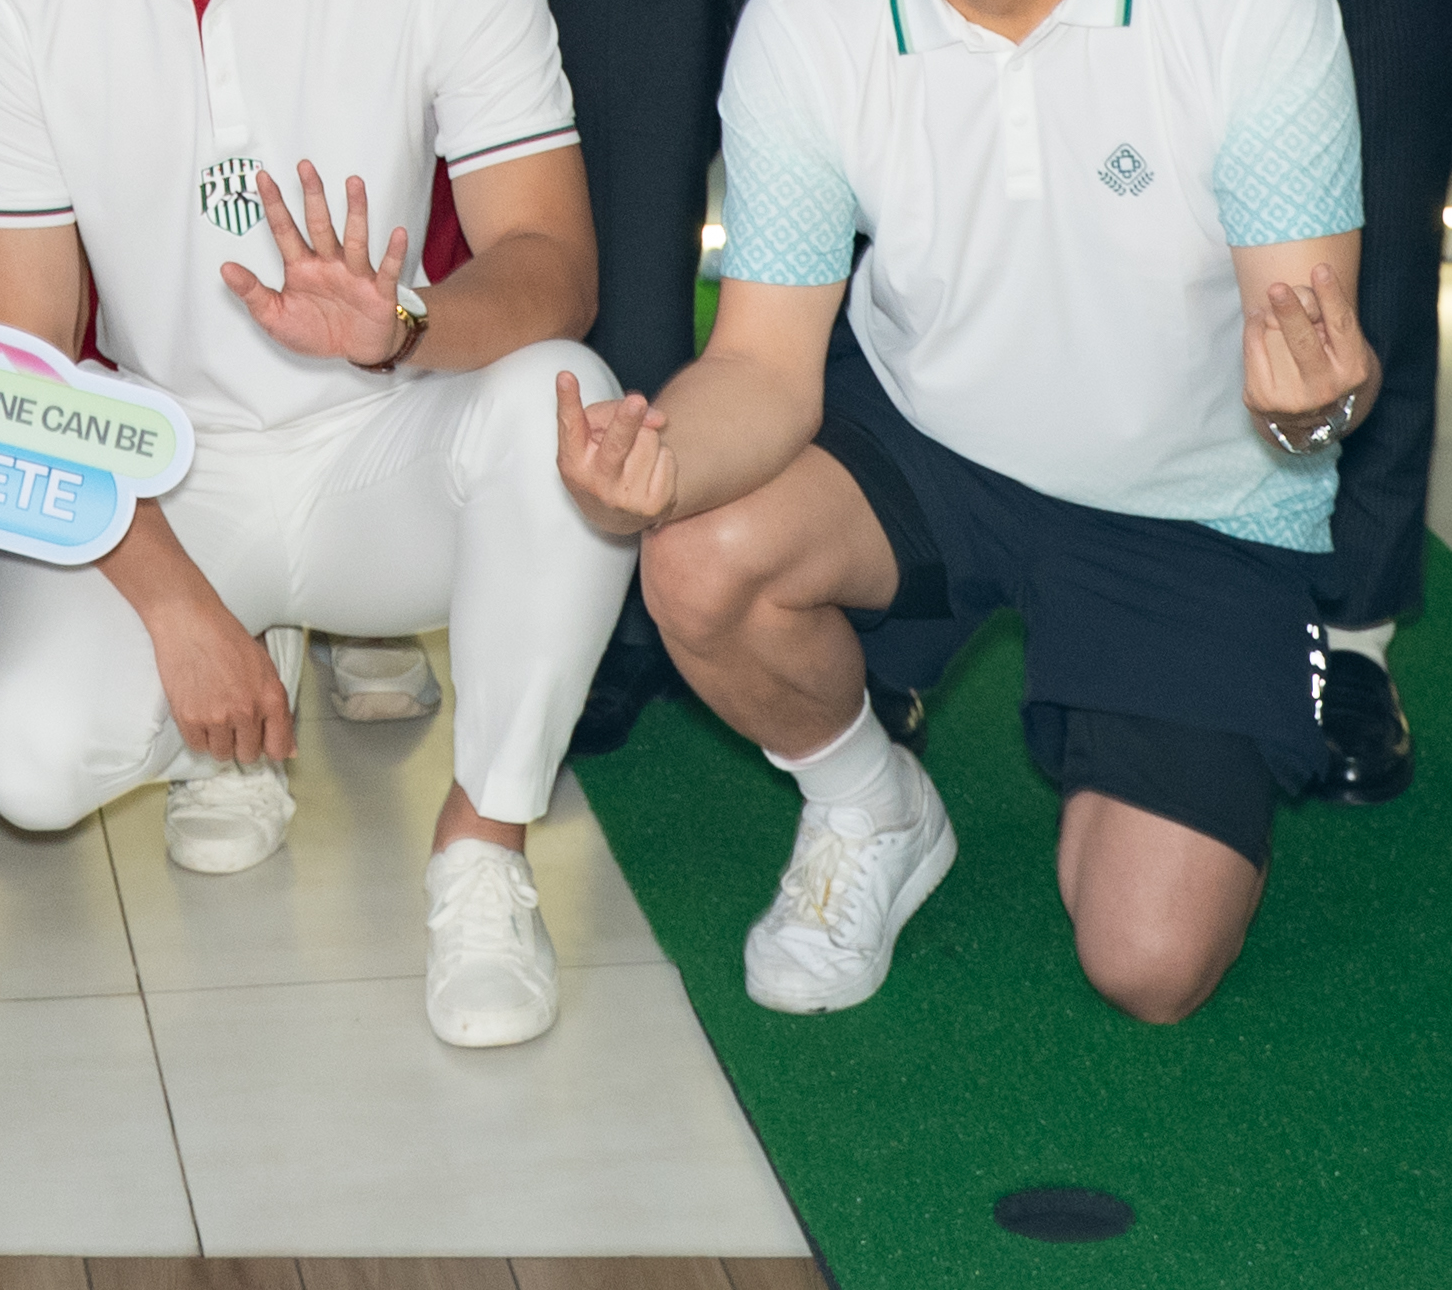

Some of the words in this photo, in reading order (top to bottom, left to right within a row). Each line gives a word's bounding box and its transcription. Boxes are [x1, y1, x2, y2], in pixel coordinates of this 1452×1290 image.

[199, 174, 259, 216] PIL
[40, 403, 110, 448] CAN
[114, 423, 158, 458] BE
